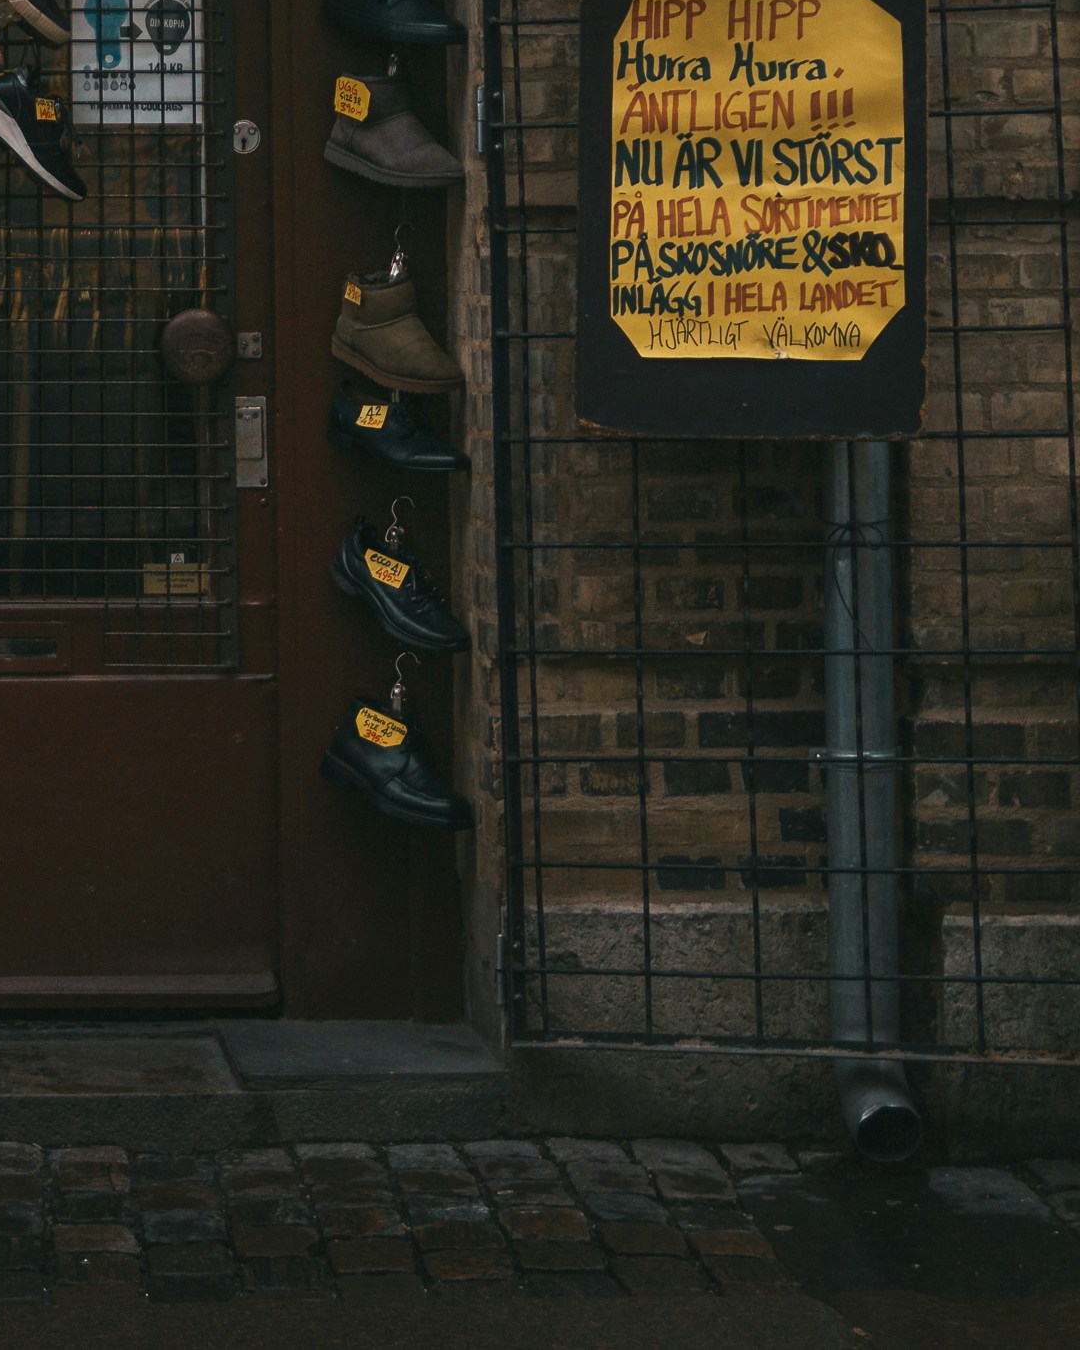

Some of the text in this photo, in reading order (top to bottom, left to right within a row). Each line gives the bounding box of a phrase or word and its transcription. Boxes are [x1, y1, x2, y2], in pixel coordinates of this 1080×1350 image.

[616, 41, 711, 86] Hurra
[338, 79, 358, 96] UGG
[340, 91, 353, 102] SIZE
[615, 132, 903, 189] NU ÄR VI STÖRST
[614, 191, 901, 239] PÅ HELA SORTIMENTET
[612, 233, 657, 281] PÅ
[802, 230, 832, 276] &
[612, 277, 702, 318] INLÄGG
[724, 281, 787, 316] HELA
[799, 279, 899, 312] LANDET
[363, 719, 379, 731] SIZE
